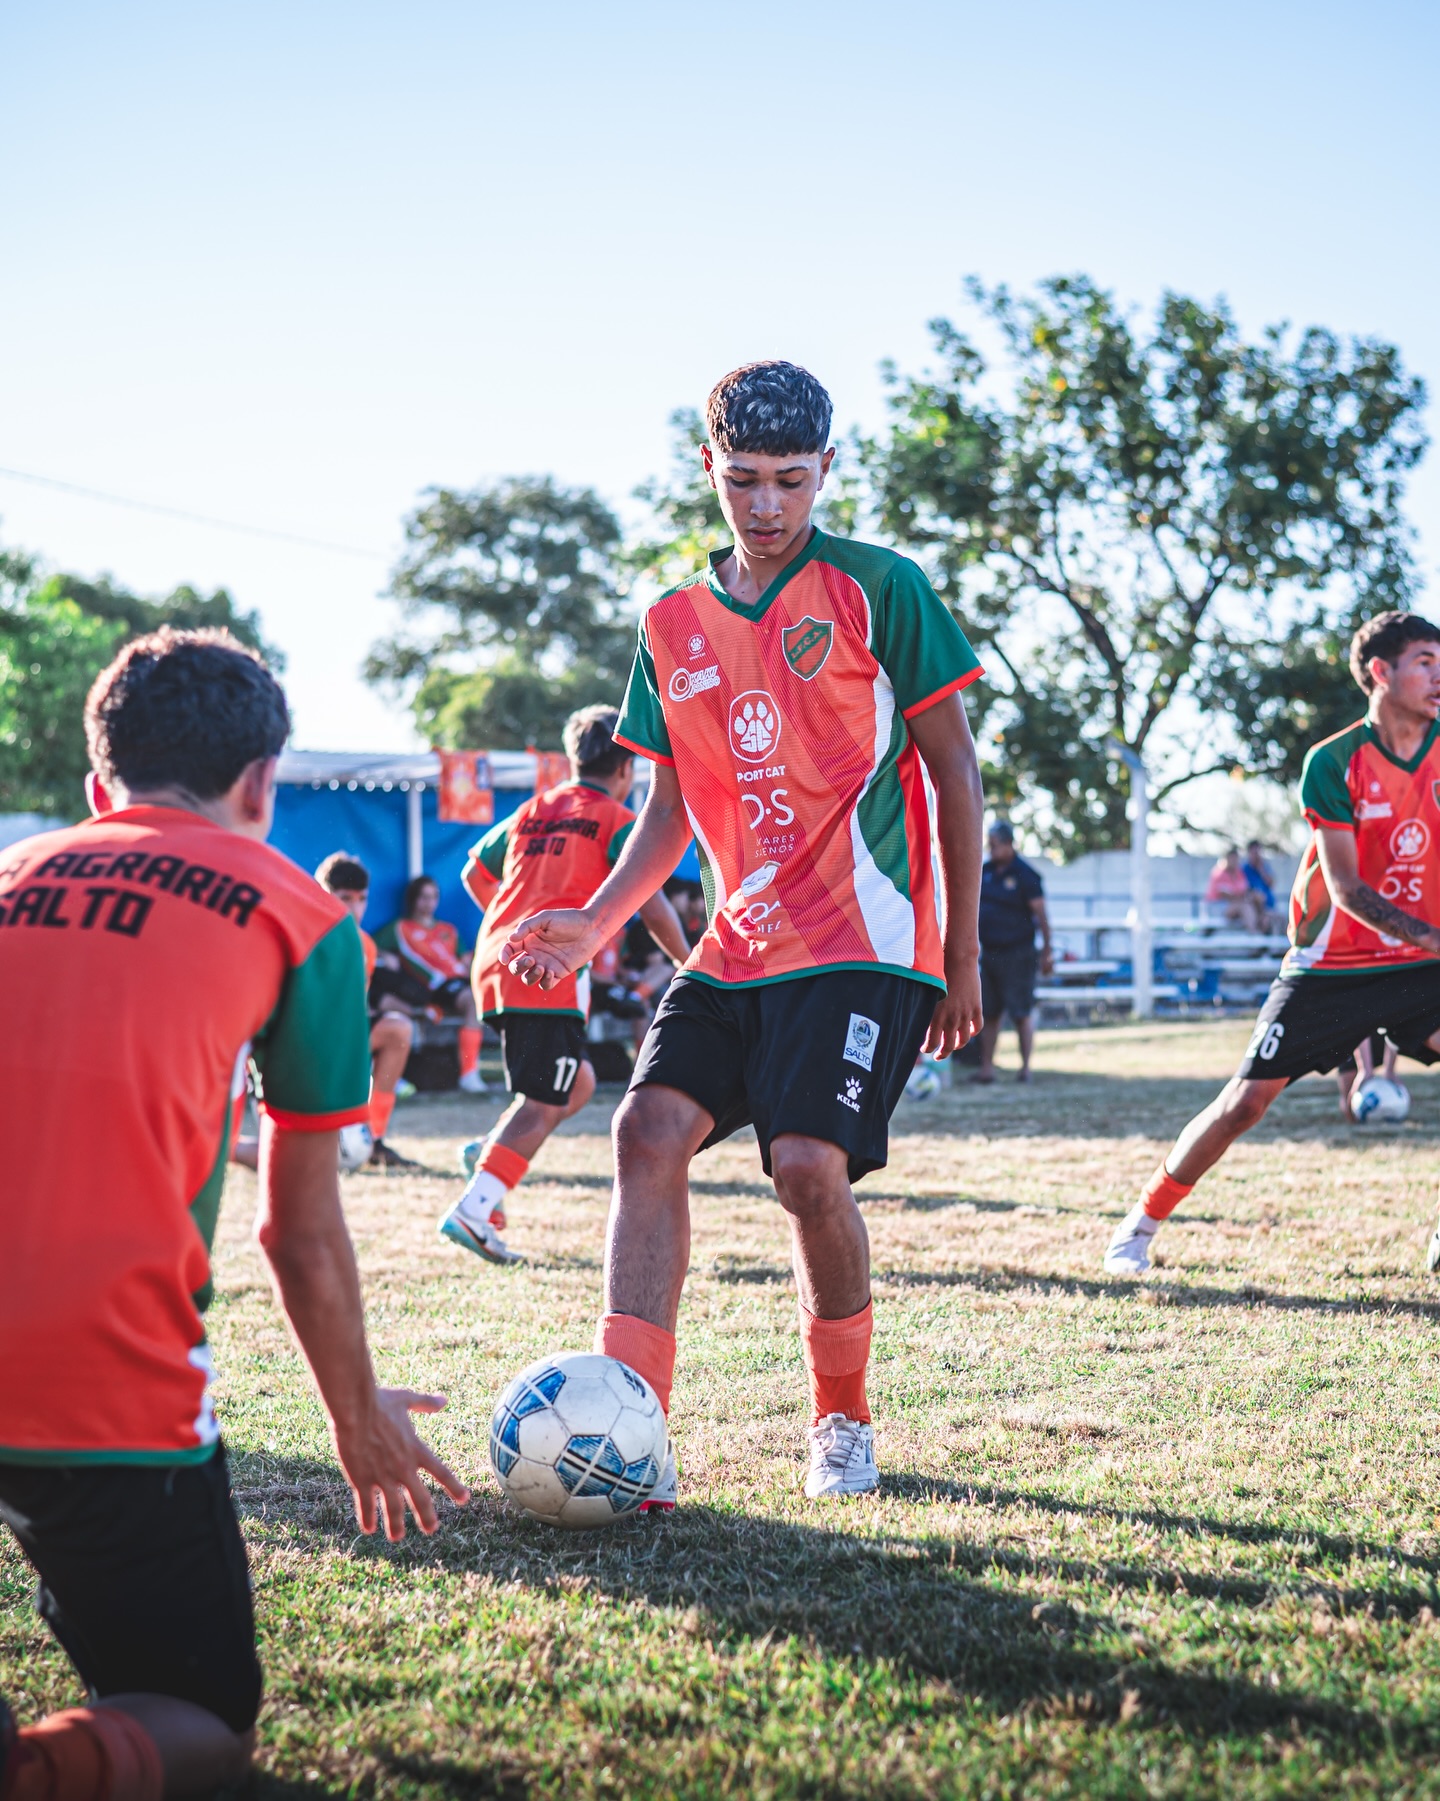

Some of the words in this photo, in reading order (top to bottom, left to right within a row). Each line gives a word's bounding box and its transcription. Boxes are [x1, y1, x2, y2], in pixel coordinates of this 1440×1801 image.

[765, 765, 786, 778] CAT
[1244, 1021, 1285, 1060] 26
[845, 1047, 871, 1066] SALTO
[553, 1056, 578, 1092] 17
[836, 1093, 861, 1113] KELME
